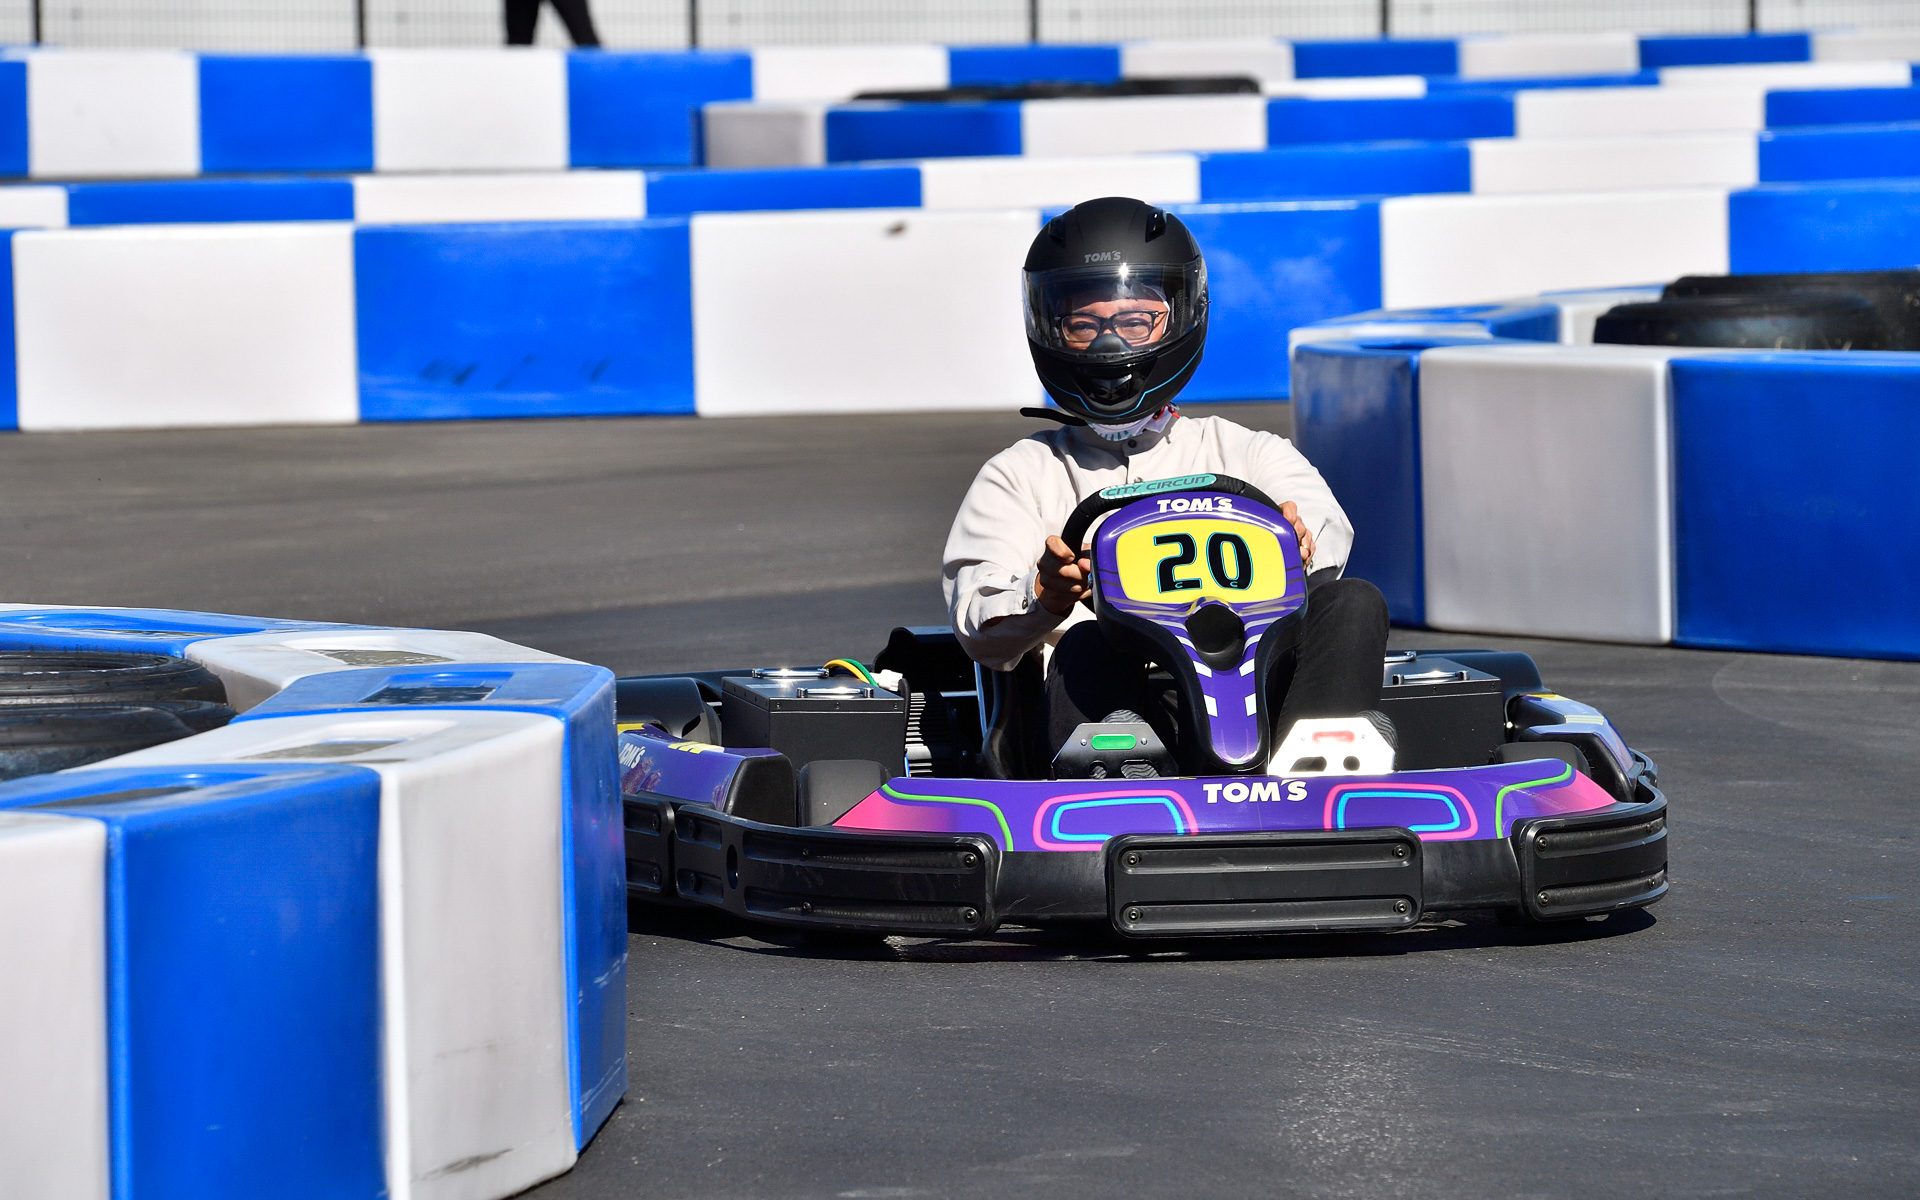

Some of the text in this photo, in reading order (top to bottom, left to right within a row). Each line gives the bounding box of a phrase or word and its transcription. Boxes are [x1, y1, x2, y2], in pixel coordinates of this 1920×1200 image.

[1084, 250, 1121, 263] TOM'S
[1106, 475, 1209, 497] CITY CIRCUIT
[1157, 496, 1232, 513] TOM'S
[1153, 531, 1254, 594] 20
[1202, 779, 1308, 804] TOM'S
